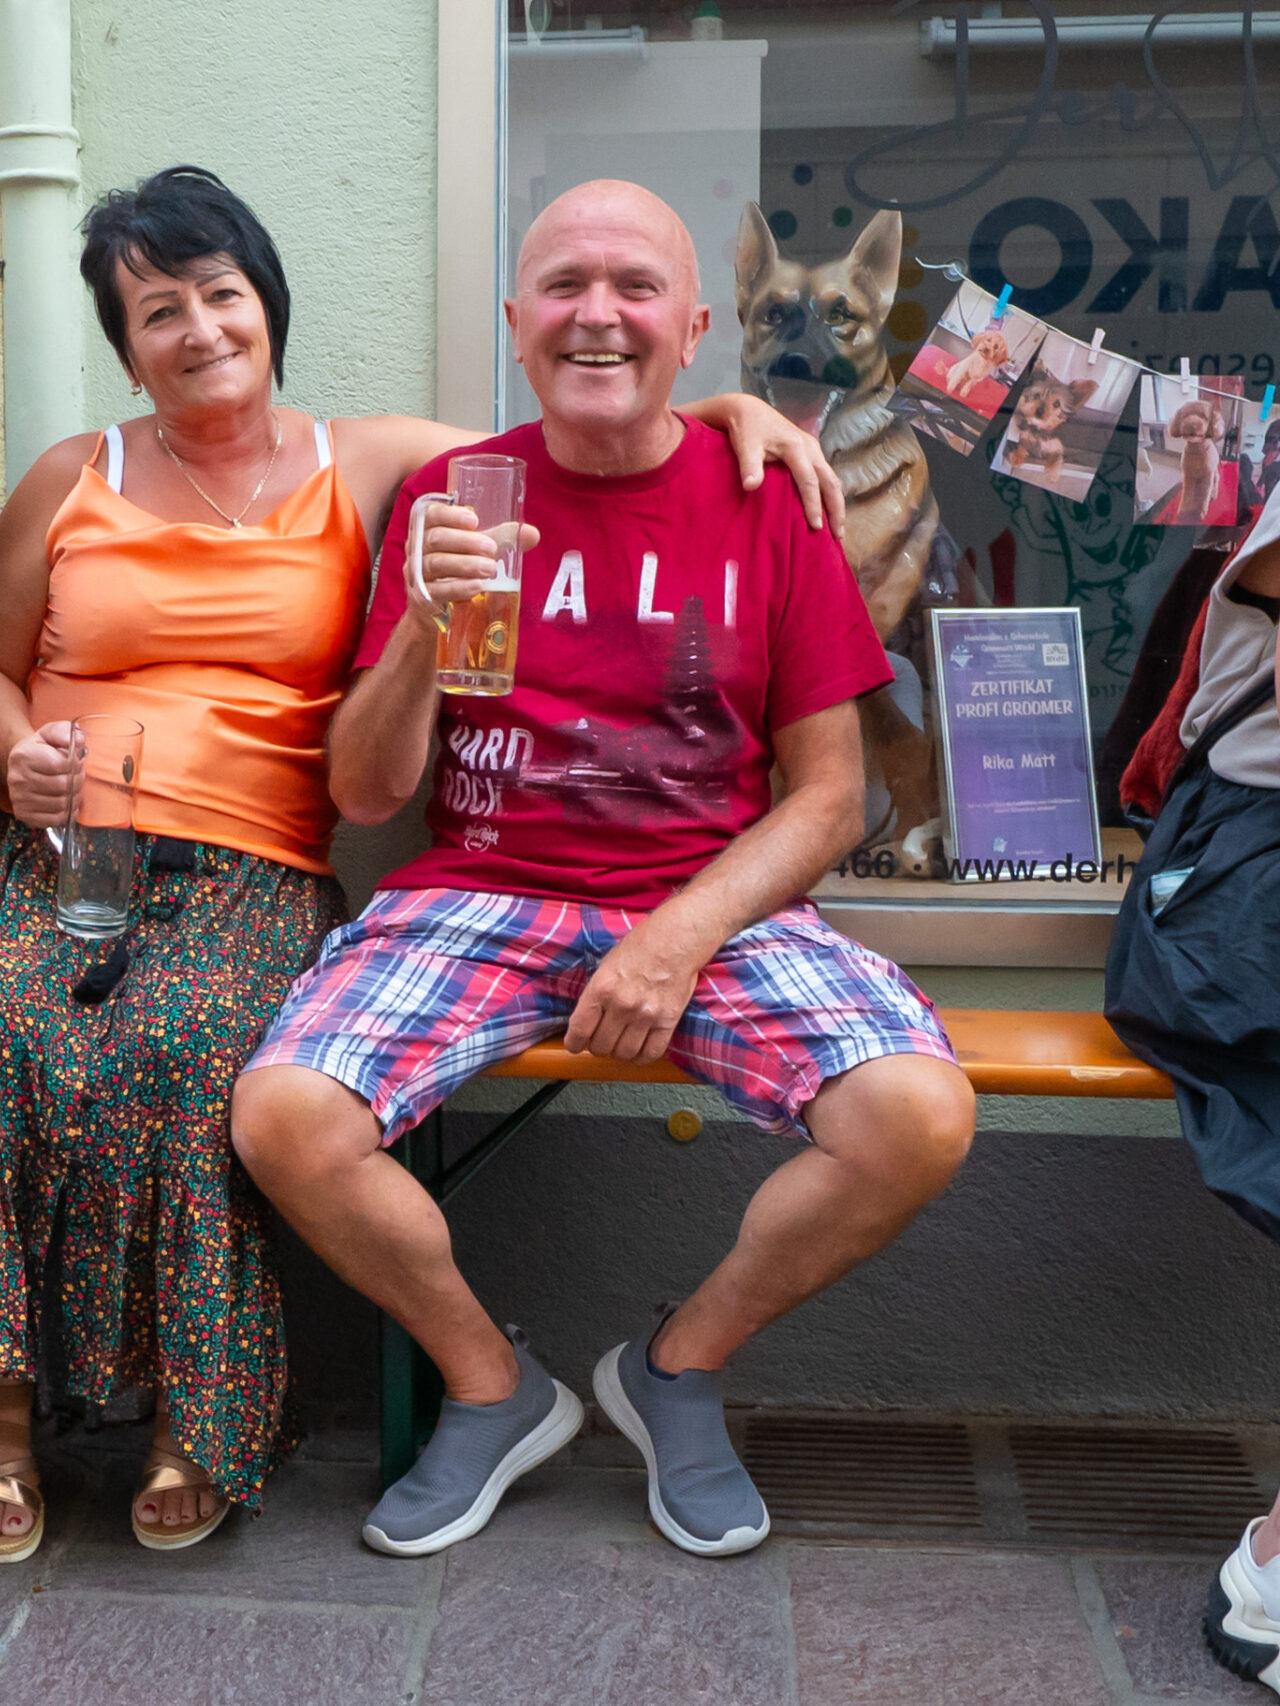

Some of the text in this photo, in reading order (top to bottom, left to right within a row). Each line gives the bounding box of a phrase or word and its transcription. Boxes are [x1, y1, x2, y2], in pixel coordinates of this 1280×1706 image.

[541, 549, 739, 629] ALI
[971, 679, 1054, 697] ZERTIFIKAT
[955, 699, 1074, 718] PROFI GROOMER
[449, 724, 535, 771] HARD
[983, 753, 1056, 770] Rika Matt
[443, 767, 505, 817] ROCK
[944, 853, 1136, 883] www.derh
